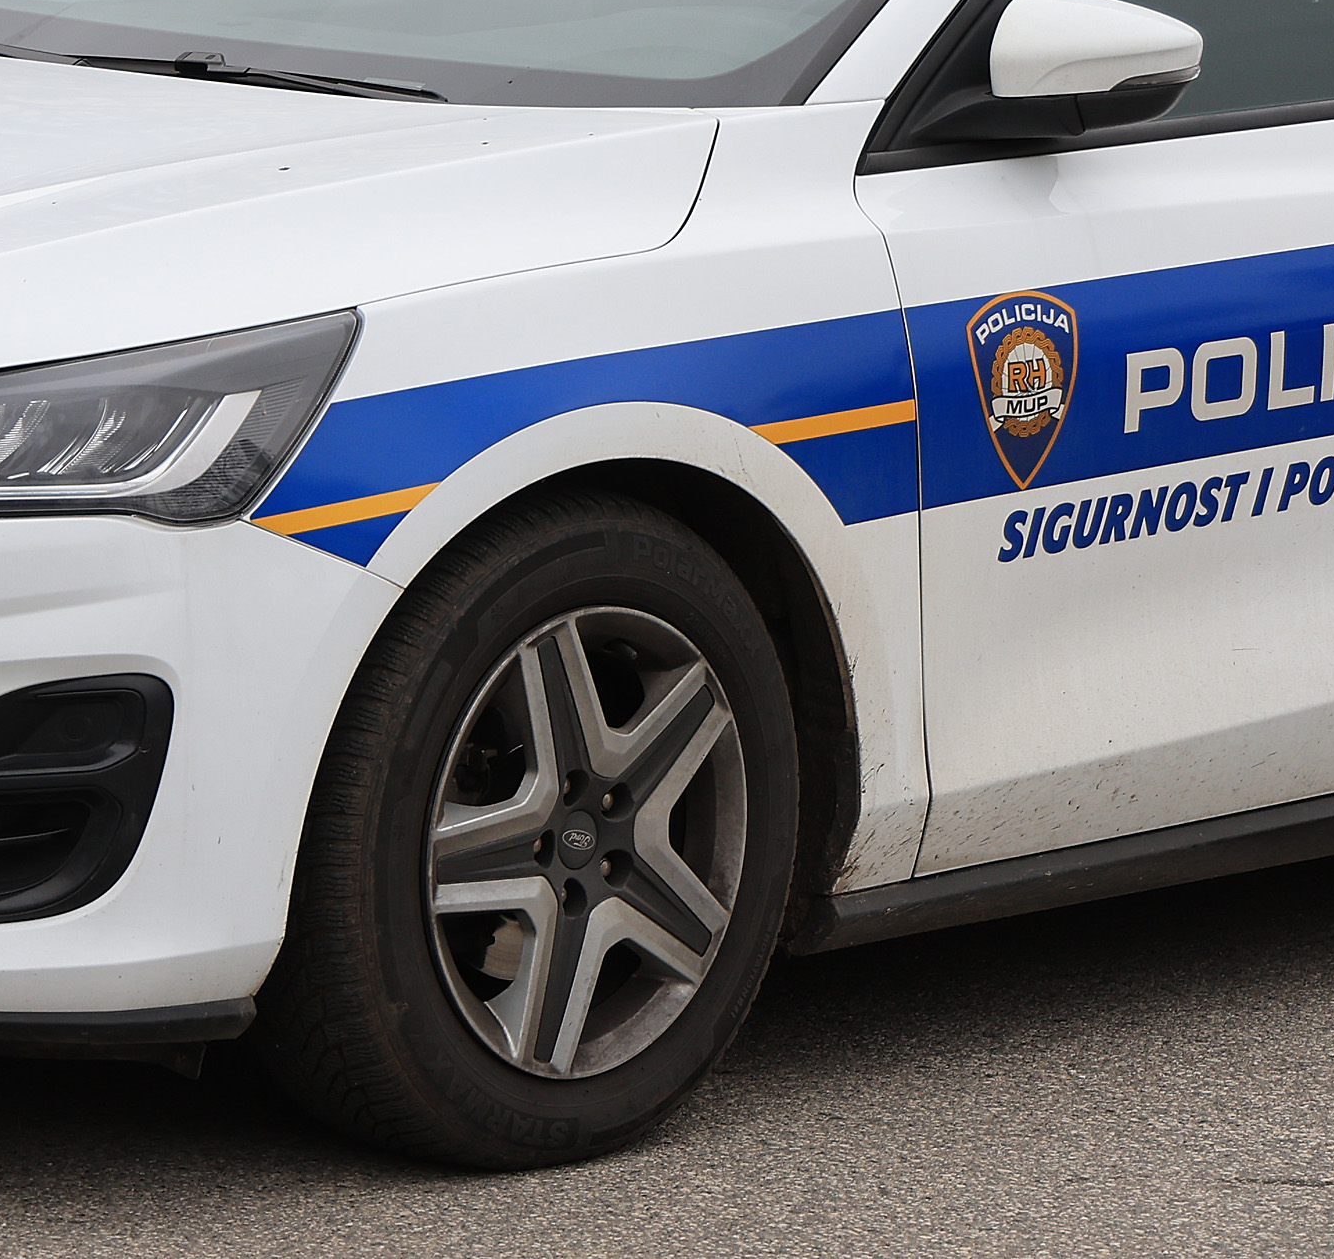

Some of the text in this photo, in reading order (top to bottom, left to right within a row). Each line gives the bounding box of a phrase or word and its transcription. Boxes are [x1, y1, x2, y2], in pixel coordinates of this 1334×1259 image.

[975, 303, 1070, 345] POLICIJA
[1008, 358, 1047, 393] RH
[1006, 395, 1048, 415] MUP
[997, 470, 1250, 563] SIGURNOST
[1251, 466, 1272, 518] I
[568, 832, 591, 848] Ford
